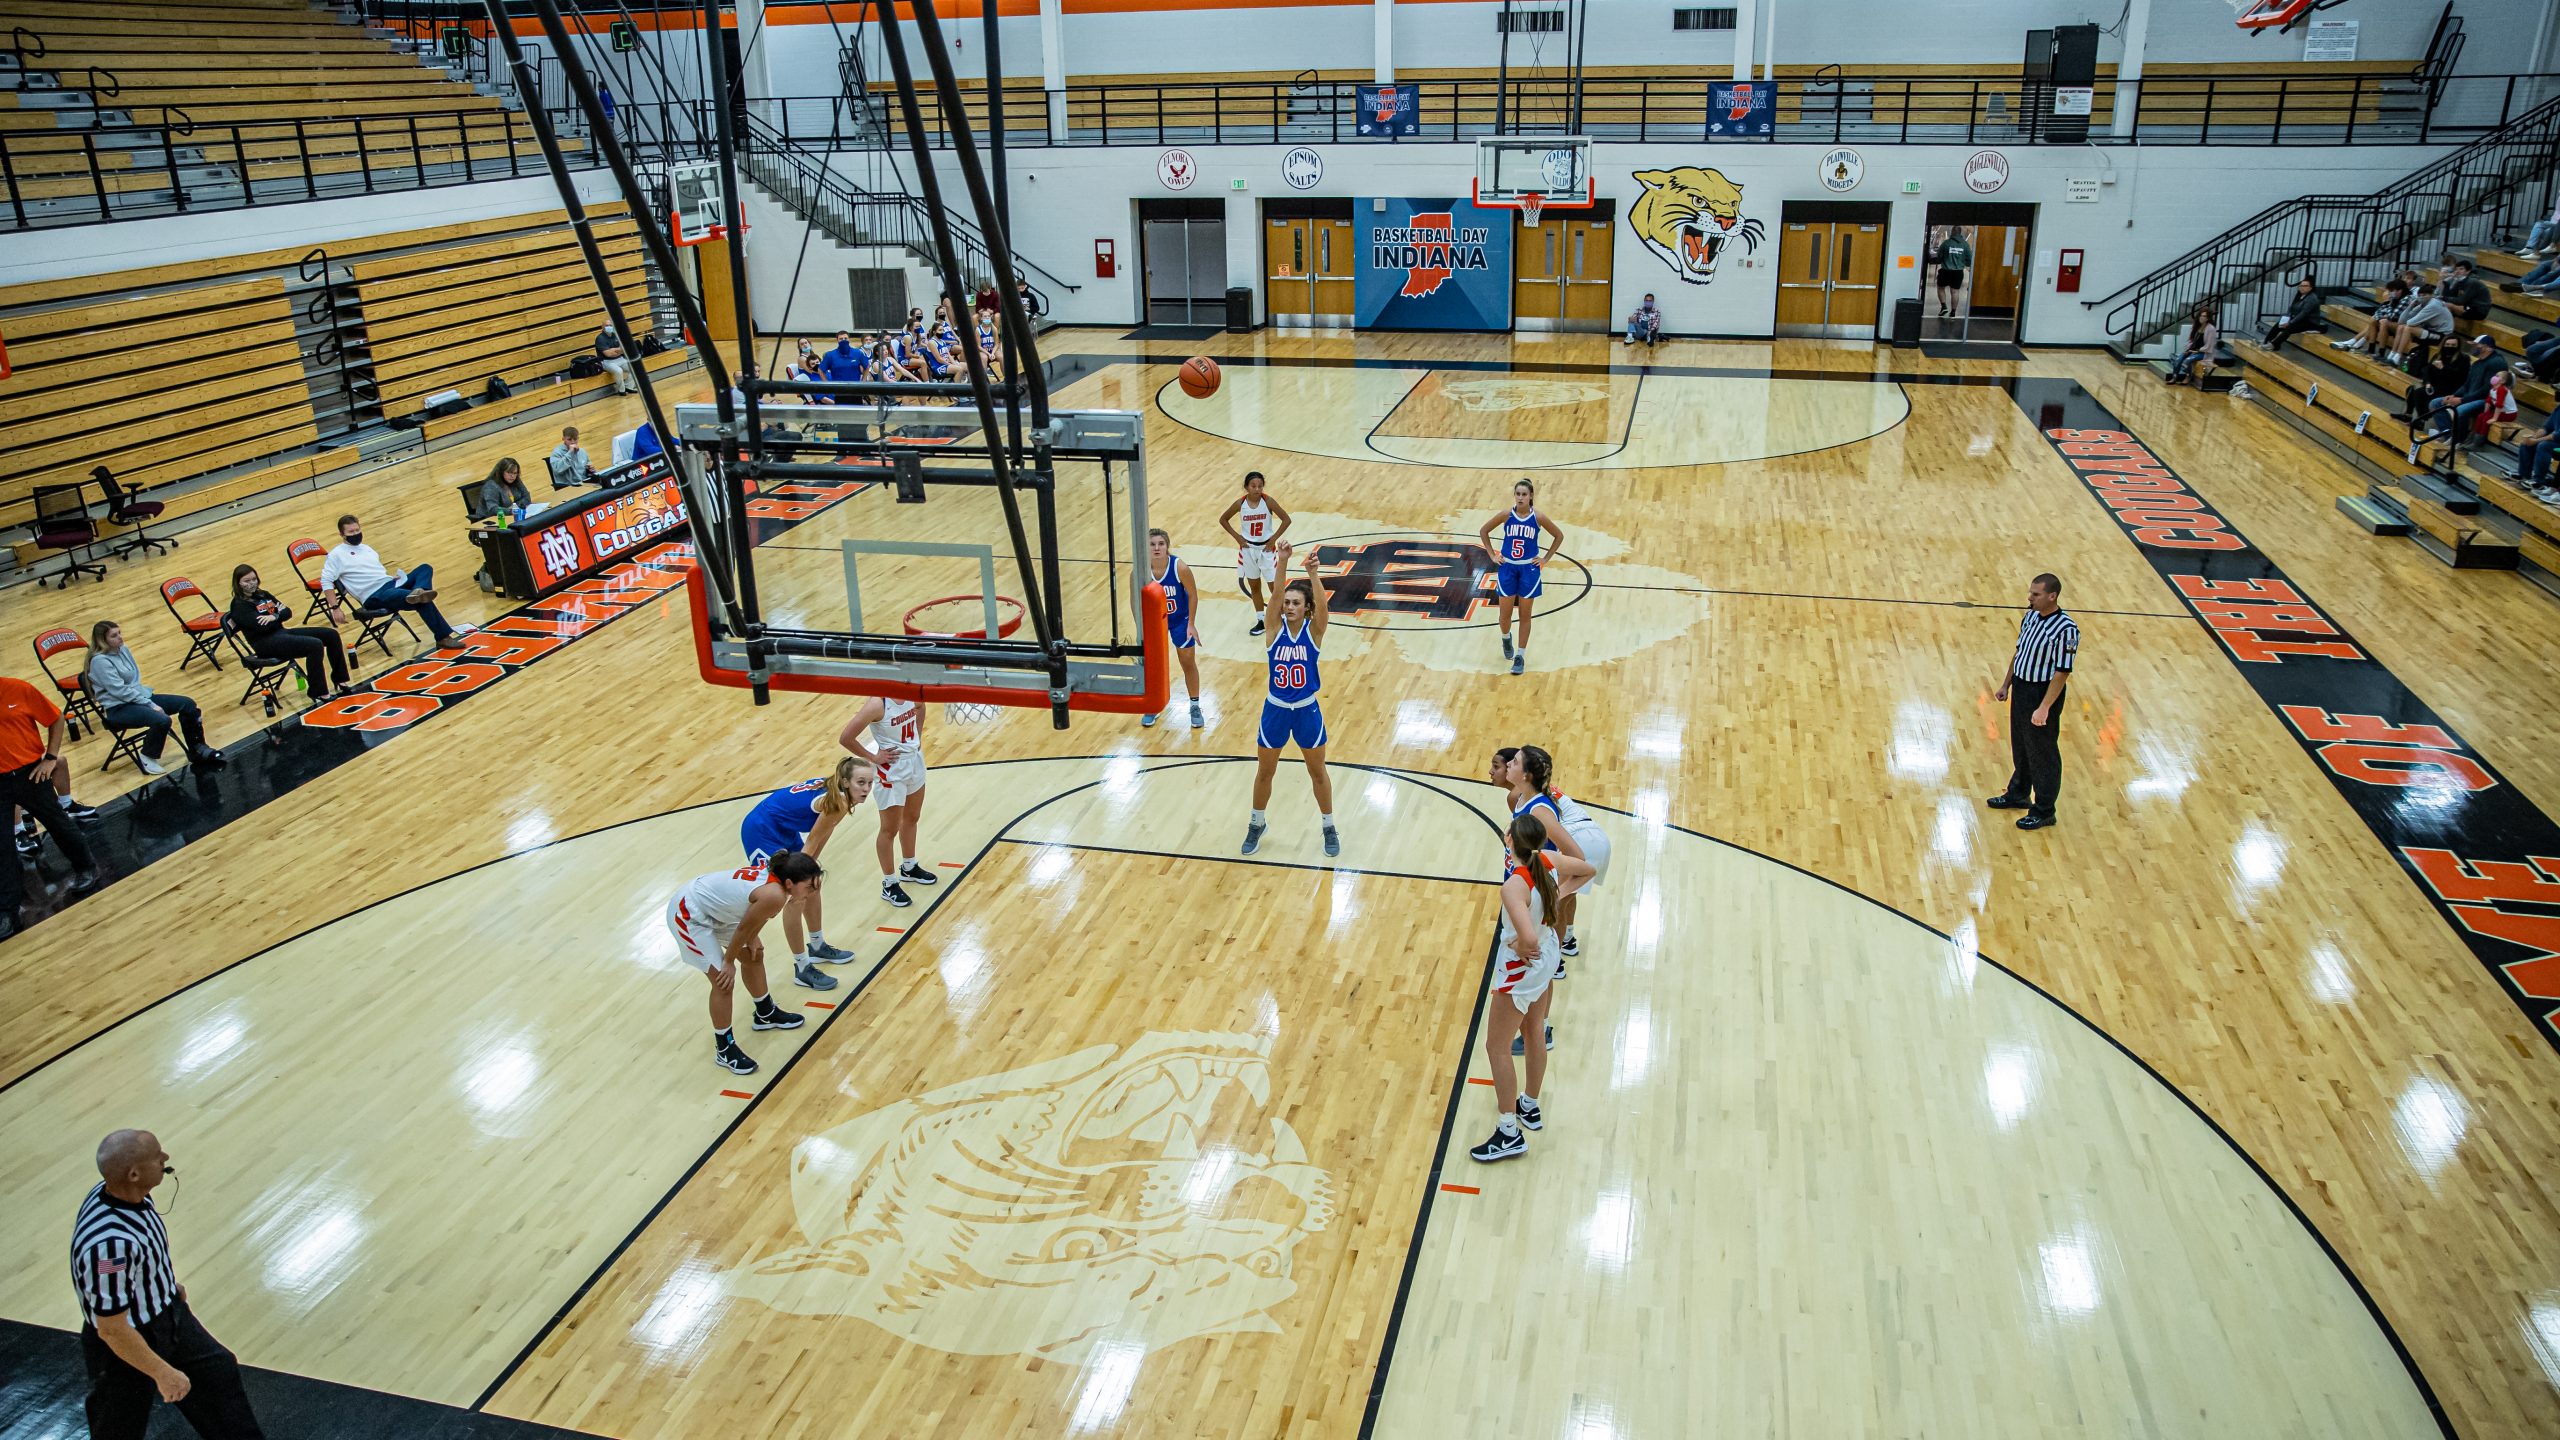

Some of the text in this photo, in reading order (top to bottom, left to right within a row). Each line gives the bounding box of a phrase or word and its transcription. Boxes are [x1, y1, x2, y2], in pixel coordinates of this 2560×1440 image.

[1364, 101, 1411, 111] INDIANA
[1717, 98, 1767, 109] INDIANA
[1163, 152, 1190, 168] ELNORA
[1289, 151, 1317, 169] EPSOM
[1826, 153, 1859, 167] PLAINVILLE
[1167, 176, 1191, 186] OWLS
[1233, 179, 1245, 188] EXIT
[1289, 171, 1317, 186] SALTS
[1827, 177, 1854, 189] MIDGETS
[1906, 182, 1918, 191] EXIT
[1972, 178, 1999, 190] ROCKETS
[1373, 228, 1488, 243] BASKETBALL DAY
[1373, 246, 1488, 270] INDIANA
[2046, 428, 2248, 550] COUGARS
[586, 496, 635, 528] NORTH
[1250, 521, 1264, 537] 12
[1506, 524, 1536, 540] LINTON
[1511, 538, 1525, 559] 5
[2167, 574, 2367, 664] THE
[1274, 663, 1307, 689] 30
[901, 719, 915, 744] 14
[2278, 704, 2499, 791] OF
